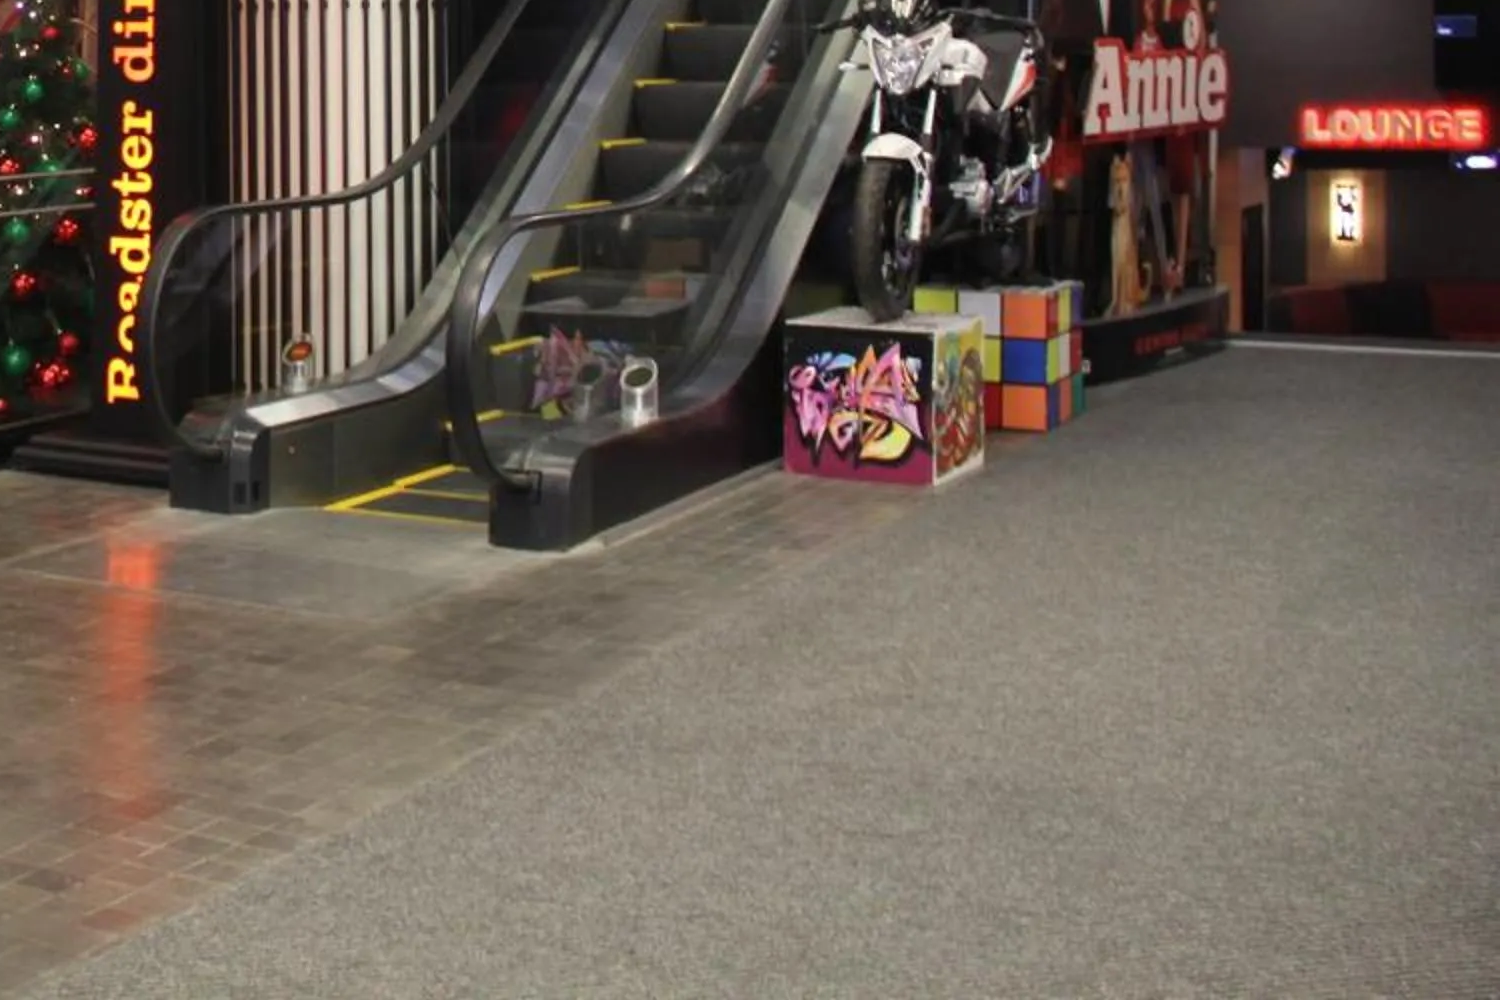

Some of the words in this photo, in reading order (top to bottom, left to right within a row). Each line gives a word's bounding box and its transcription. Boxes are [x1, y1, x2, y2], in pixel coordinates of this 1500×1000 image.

[1082, 8, 1230, 136] Annie
[1303, 108, 1483, 144] LOUNGE
[107, 100, 154, 404] Roadster
